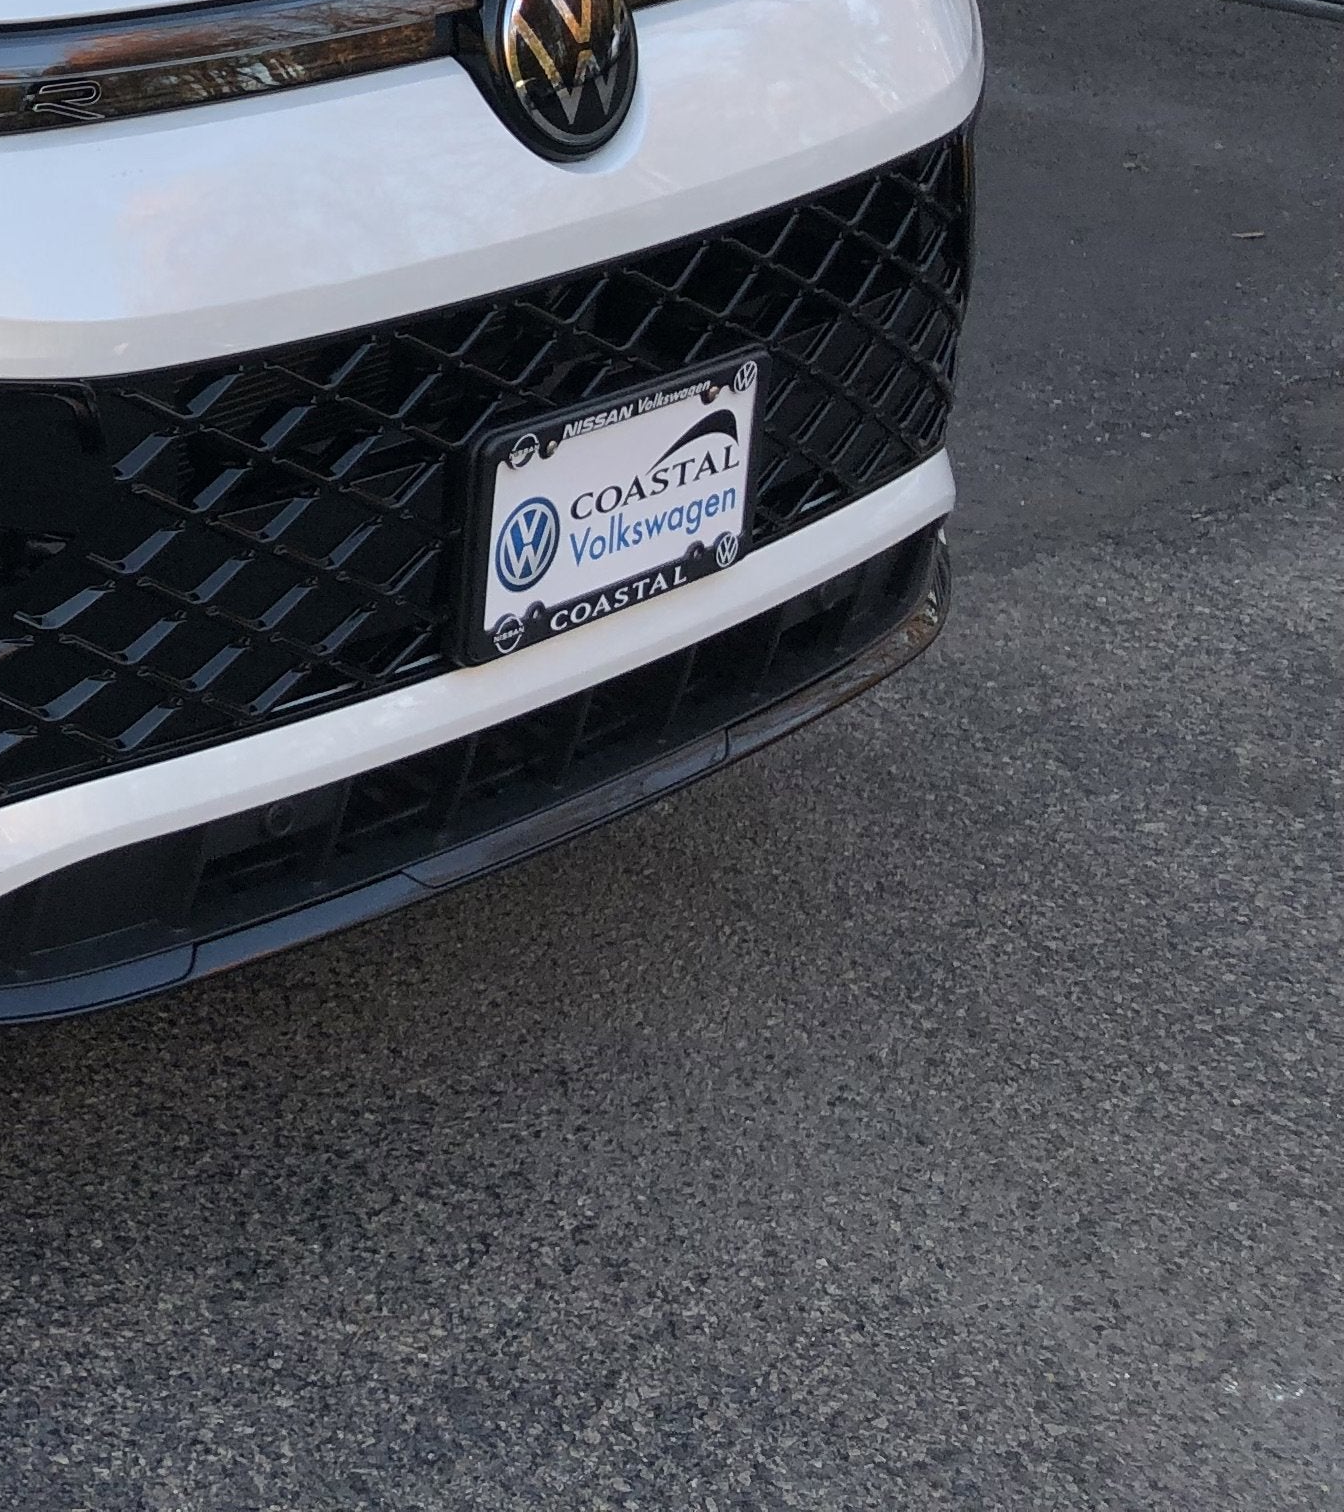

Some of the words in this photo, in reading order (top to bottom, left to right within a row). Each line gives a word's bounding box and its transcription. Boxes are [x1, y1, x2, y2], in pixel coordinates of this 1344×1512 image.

[563, 403, 633, 439] NISSAN
[638, 380, 711, 414] Volkswagen
[570, 445, 740, 520] COASTAL
[570, 487, 736, 567] Volkswagen
[550, 566, 687, 631] COASTAL
